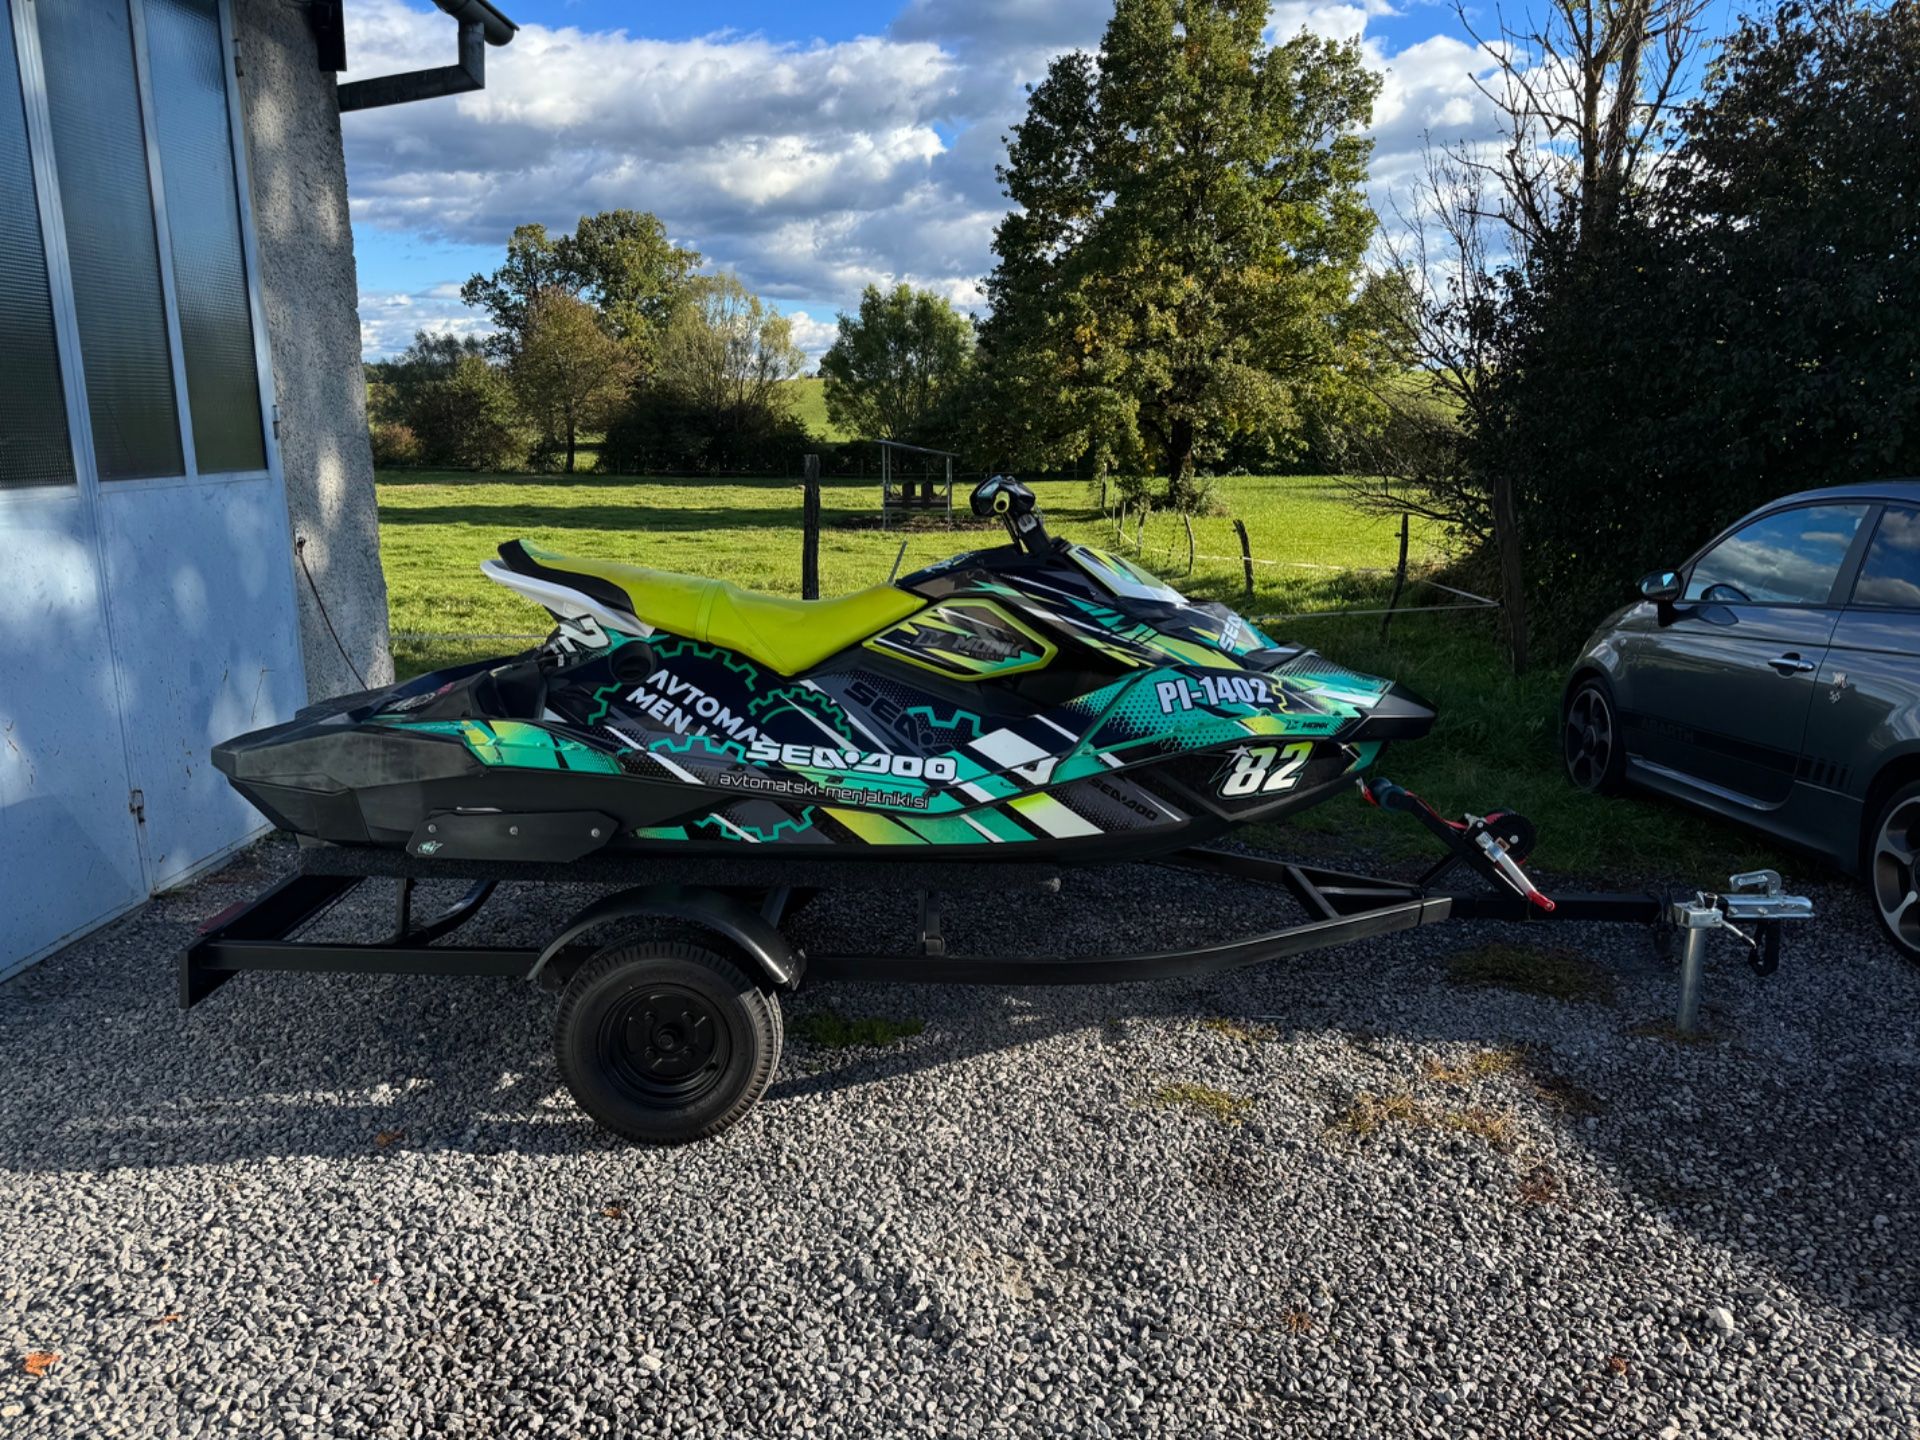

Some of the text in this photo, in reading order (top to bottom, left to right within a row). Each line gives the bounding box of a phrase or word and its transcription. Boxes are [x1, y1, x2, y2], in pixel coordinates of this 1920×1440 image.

[1155, 675, 1274, 714] PI-1402
[1220, 741, 1315, 797] 82
[719, 772, 929, 809] avtomatski-menjalniki.si
